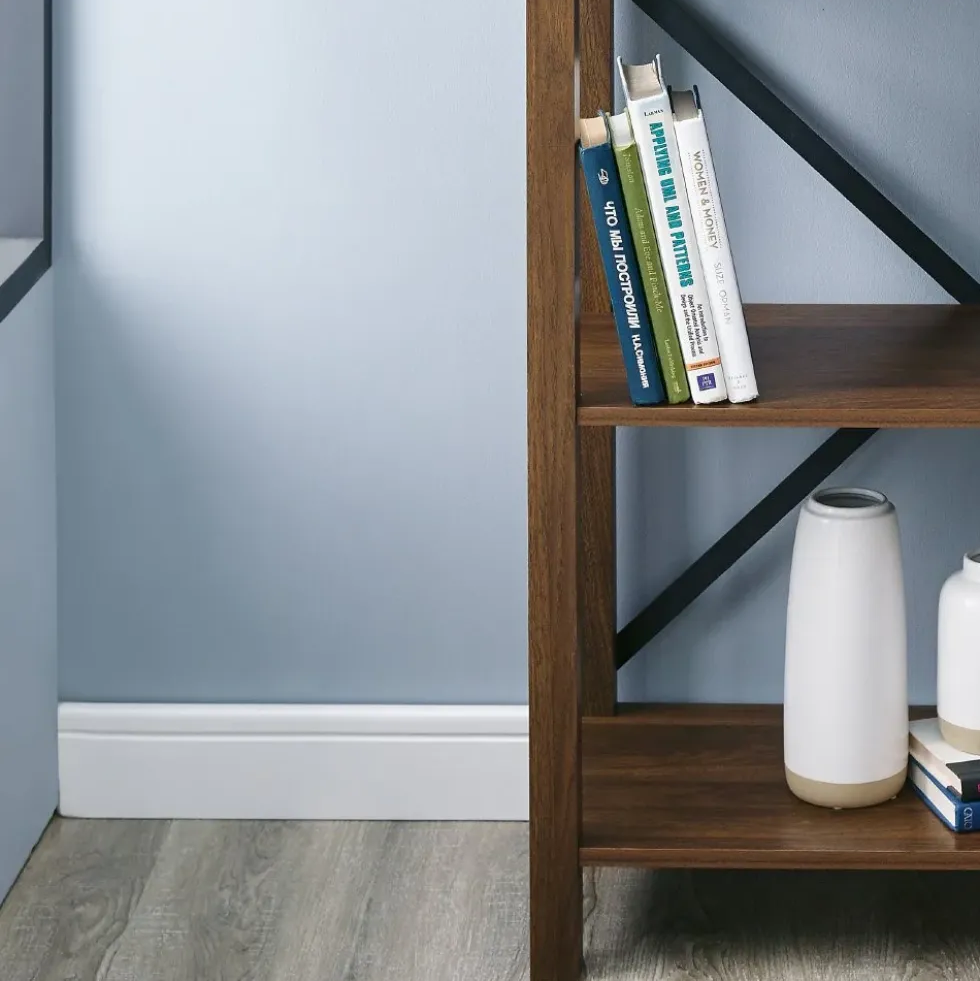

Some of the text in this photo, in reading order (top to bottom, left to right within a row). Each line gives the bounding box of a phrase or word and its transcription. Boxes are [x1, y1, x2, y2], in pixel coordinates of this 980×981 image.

[650, 122, 694, 288] APPLYING UML AND PATTERNS
[693, 151, 709, 195] WOMEN
[703, 209, 718, 249] MONEY
[604, 201, 641, 328] ЧТО МЫ ПОСТРОИЛИ
